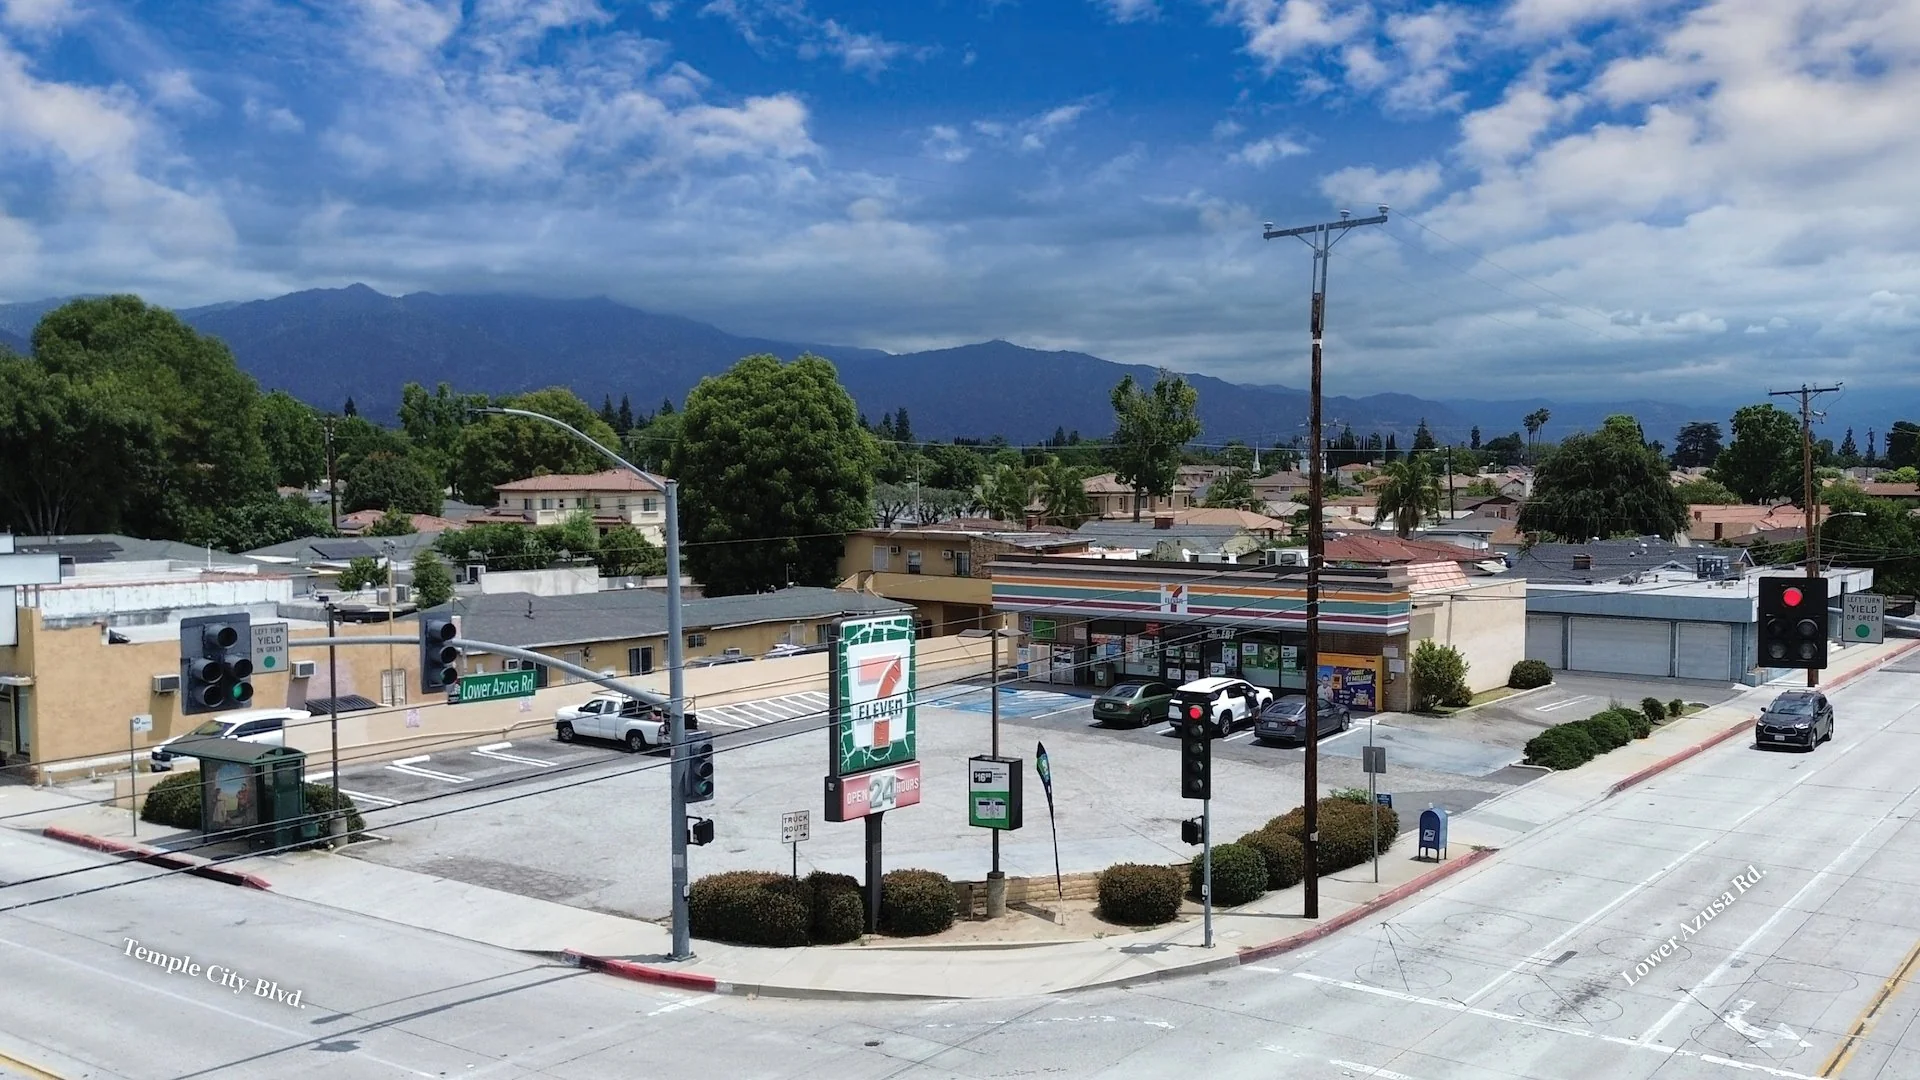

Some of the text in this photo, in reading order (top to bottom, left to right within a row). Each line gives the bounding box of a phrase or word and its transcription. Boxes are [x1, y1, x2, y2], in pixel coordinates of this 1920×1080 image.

[1849, 604, 1877, 613] YIELD
[270, 626, 284, 634] TURN
[257, 635, 282, 645] YIELD
[462, 681, 492, 700] Lower
[492, 678, 519, 696] Azusa
[522, 673, 534, 692] Rd
[858, 654, 902, 748] 7
[846, 774, 920, 809] OPEN 24 HOURS
[784, 815, 807, 823] TRUCK
[784, 824, 807, 832] ROUTE
